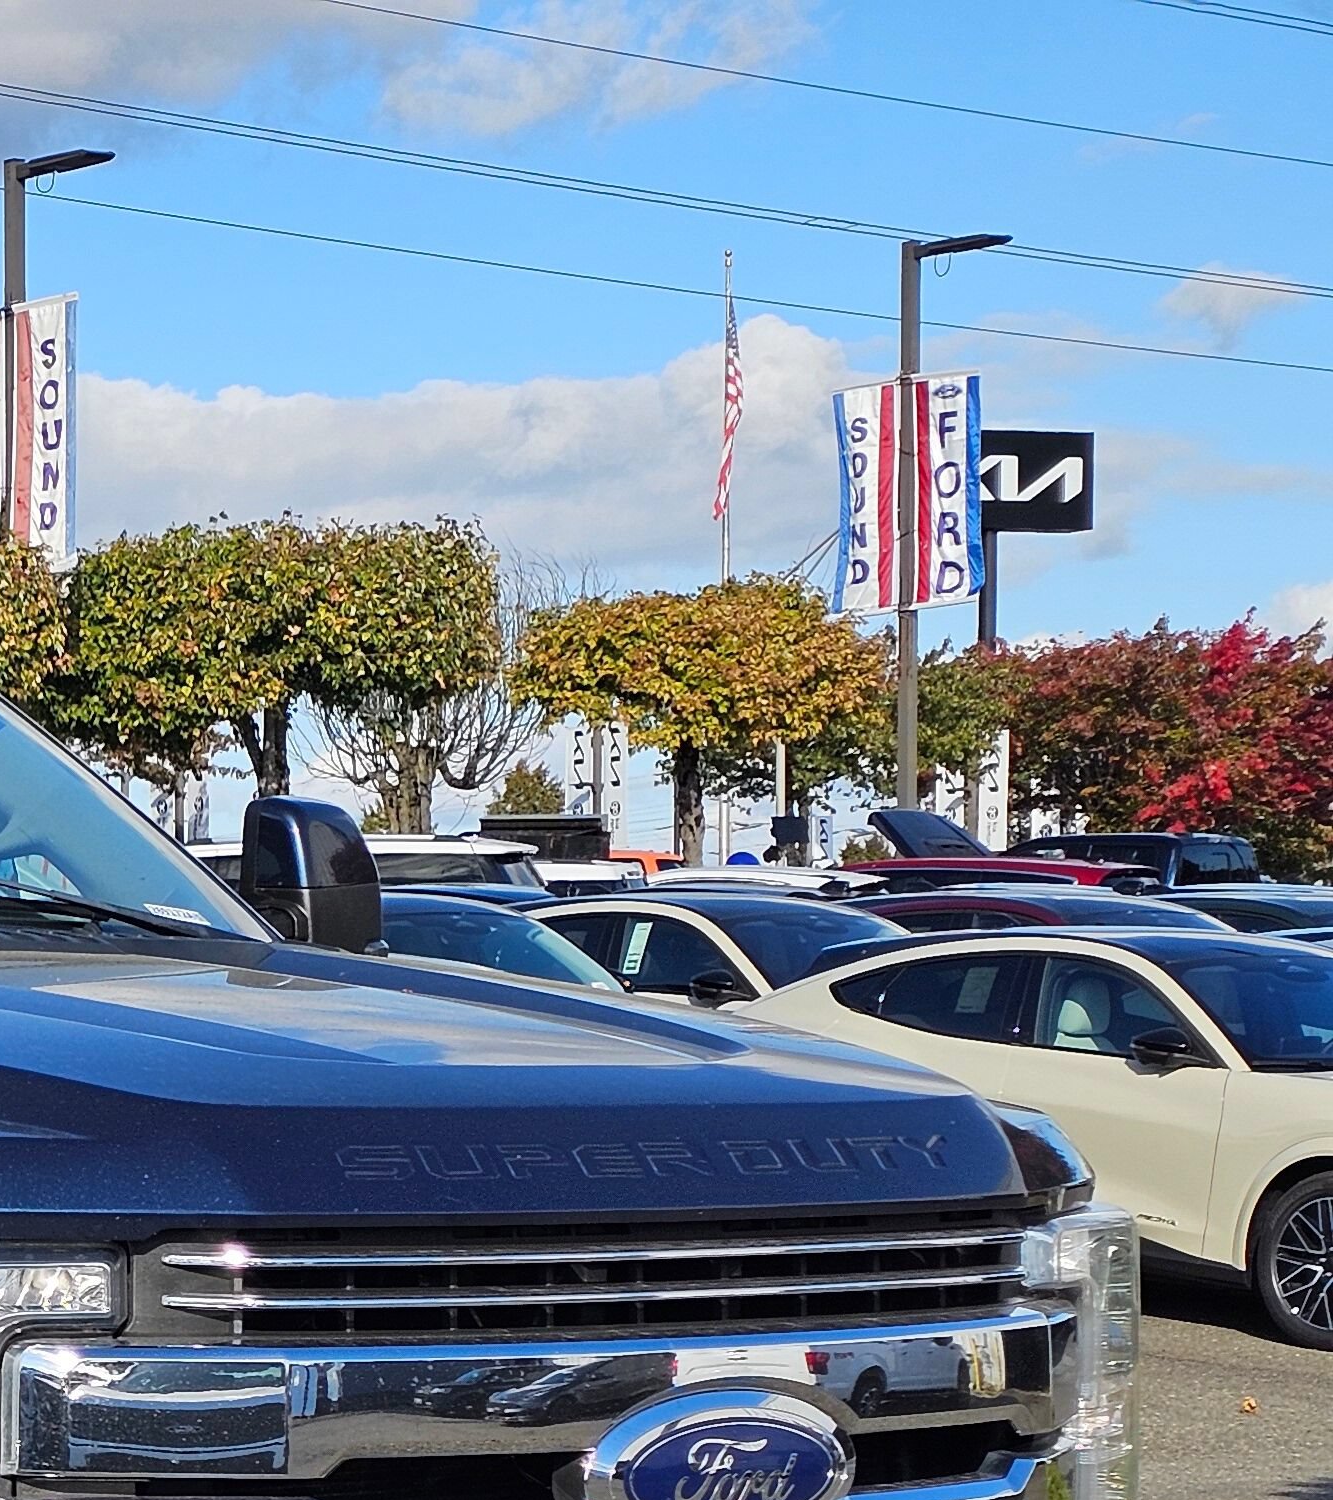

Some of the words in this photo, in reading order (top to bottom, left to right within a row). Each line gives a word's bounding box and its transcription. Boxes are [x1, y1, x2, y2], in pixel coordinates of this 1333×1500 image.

[39, 338, 63, 531] SOUND
[849, 417, 871, 585] SOUND
[933, 411, 965, 595] FORD
[335, 1141, 715, 1182] SUPER
[720, 1133, 948, 1177] DUTY
